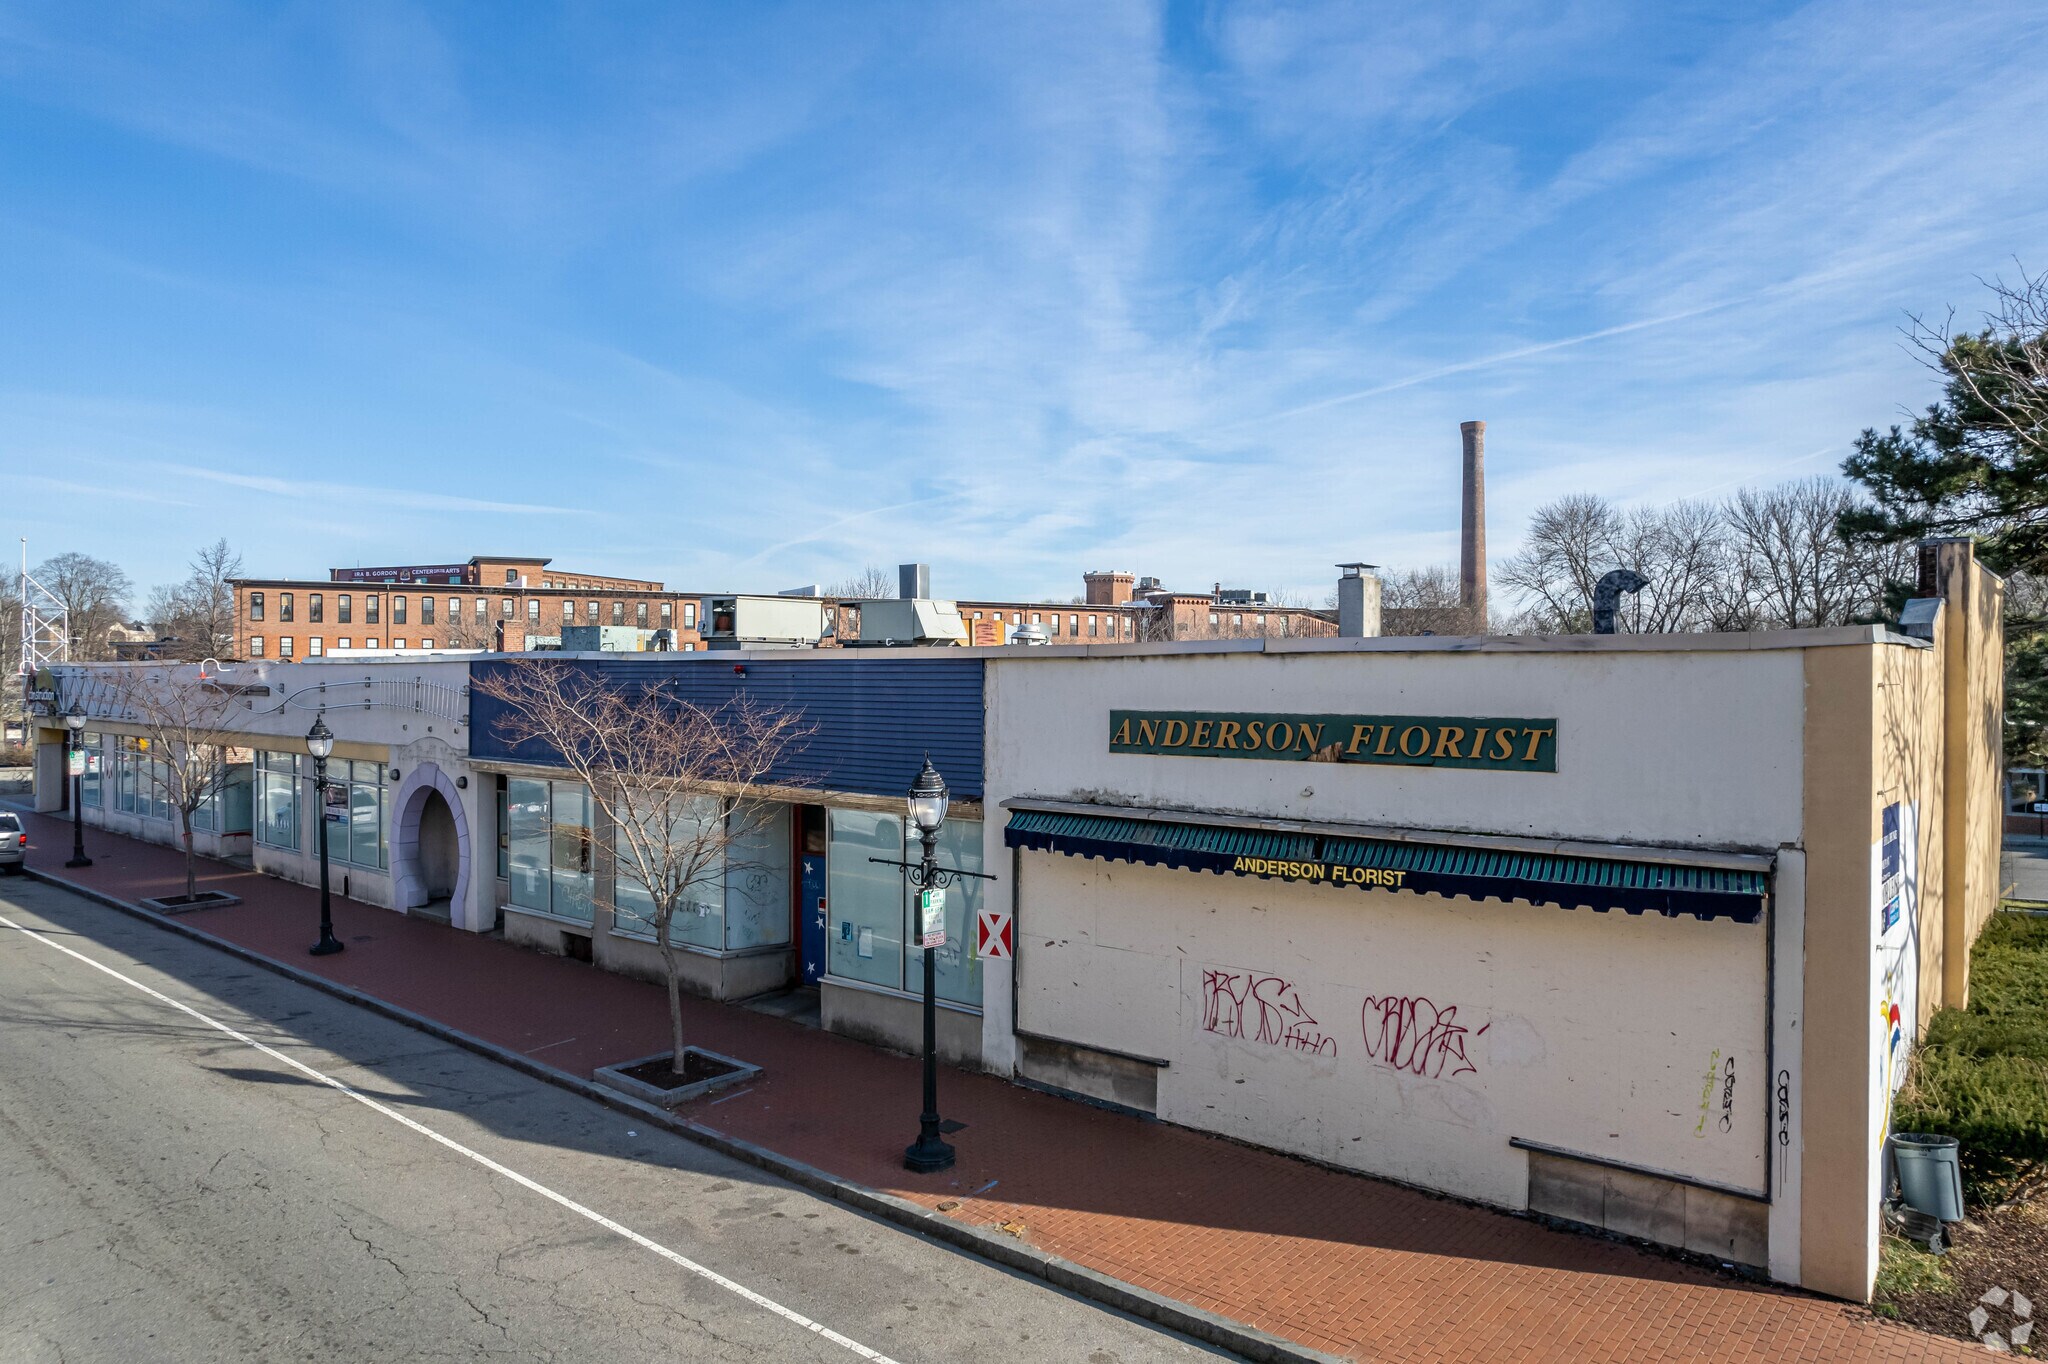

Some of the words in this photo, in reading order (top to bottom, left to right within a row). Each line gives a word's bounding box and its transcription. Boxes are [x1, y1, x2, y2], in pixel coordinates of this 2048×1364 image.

[1110, 718, 1326, 753] ANDERSON
[1345, 724, 1554, 762] FLORIST
[1233, 856, 1325, 879] ANDERSON
[1332, 866, 1406, 887] FLORIST
